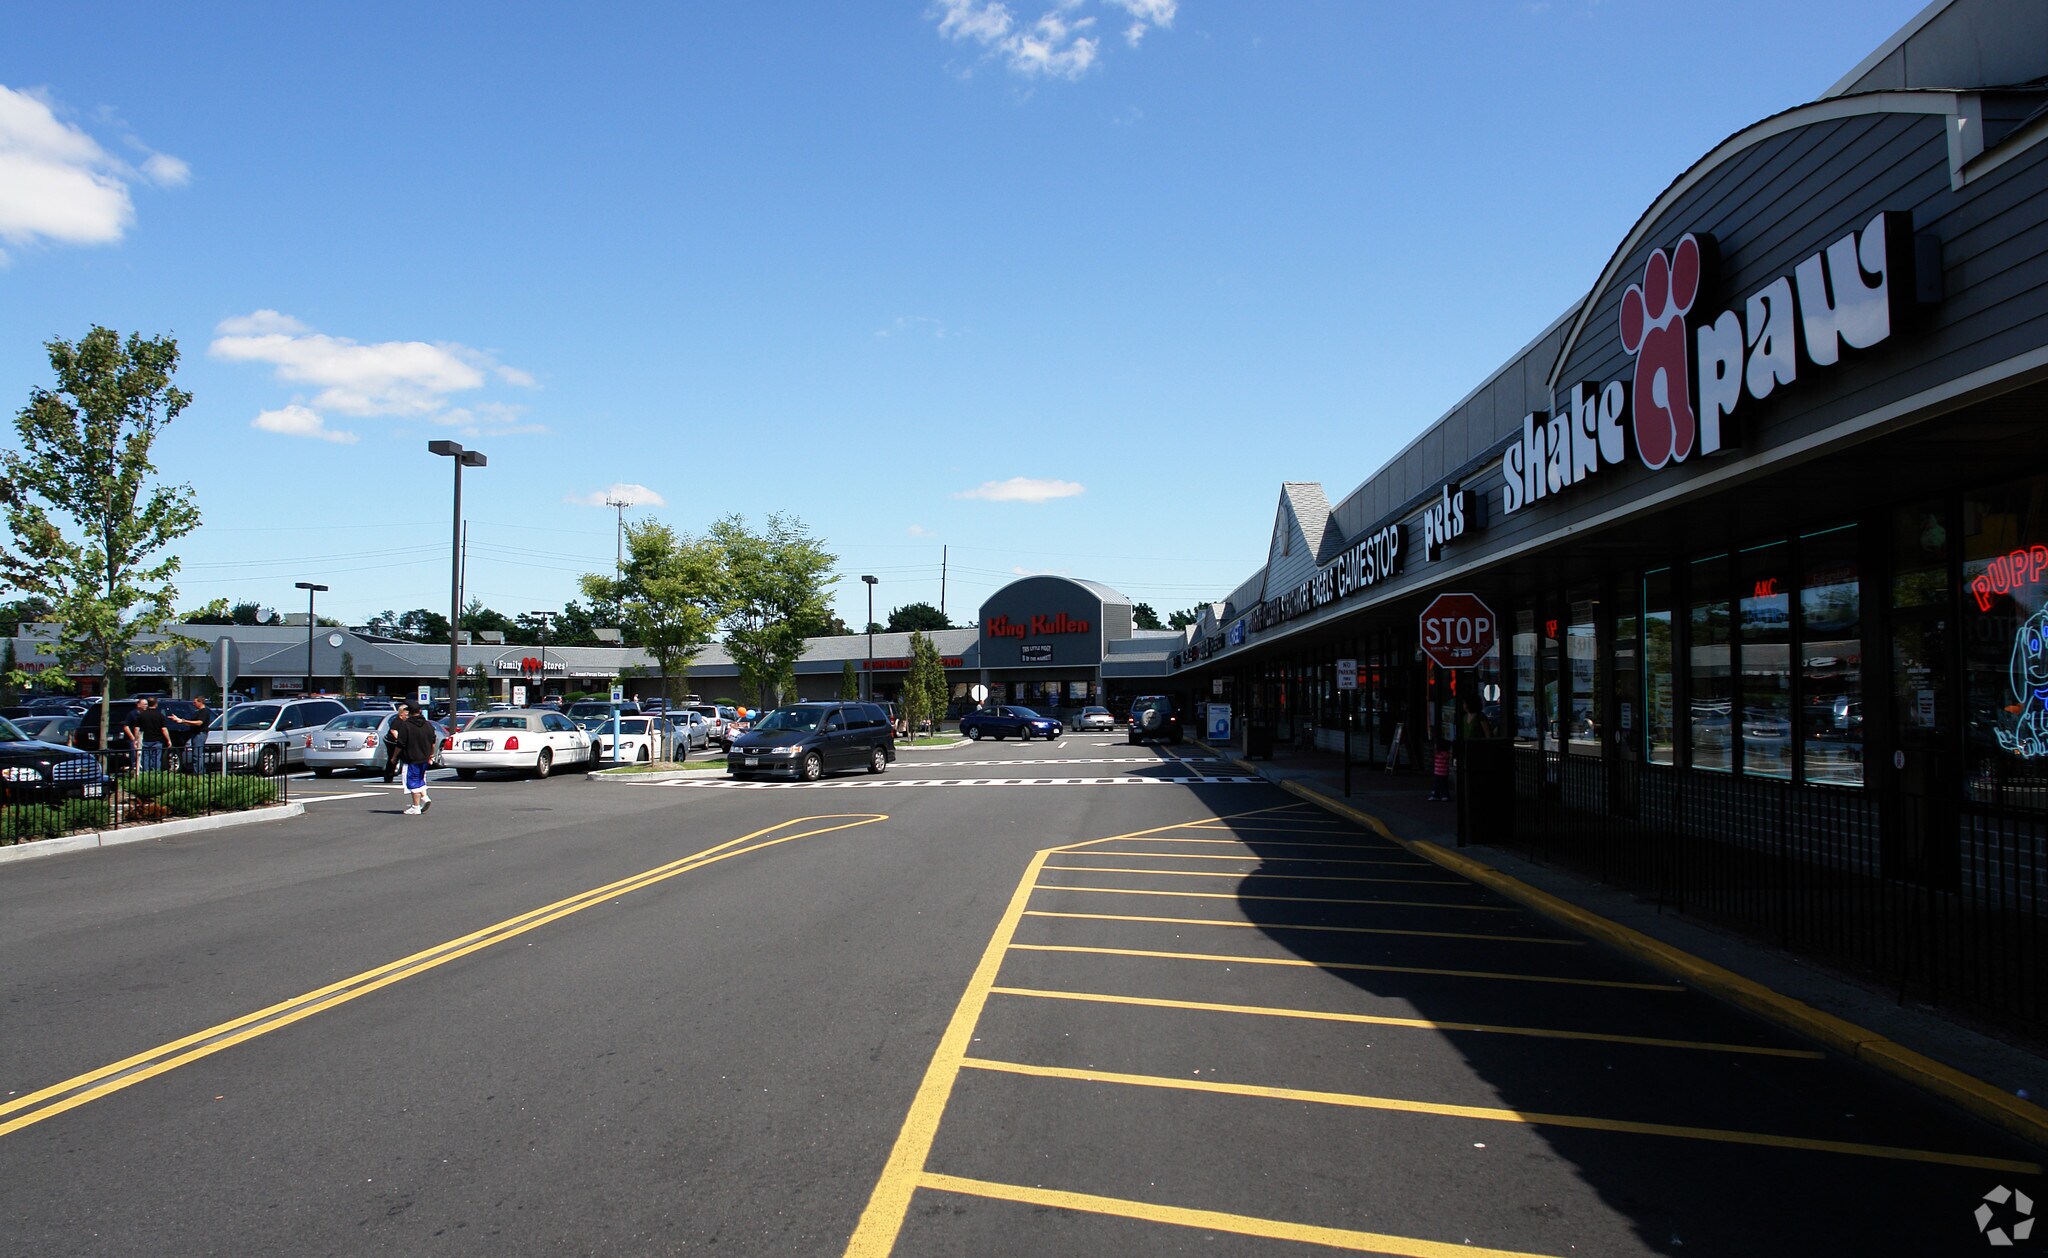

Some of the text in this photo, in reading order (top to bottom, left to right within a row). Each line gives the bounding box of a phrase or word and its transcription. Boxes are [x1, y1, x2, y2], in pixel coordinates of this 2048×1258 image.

[1503, 380, 1625, 516] shake
[1697, 211, 1892, 457] paw
[1424, 482, 1465, 562] pets
[1337, 523, 1400, 599] GAMESTOP
[1755, 578, 1778, 599] AKC
[1971, 544, 2048, 612] PUPP
[987, 612, 1089, 640] King Kullen
[1425, 616, 1490, 646] STOP
[123, 664, 167, 673] dioShack
[498, 660, 522, 672] Family
[543, 660, 566, 670] Stores
[1342, 661, 1352, 669] NO
